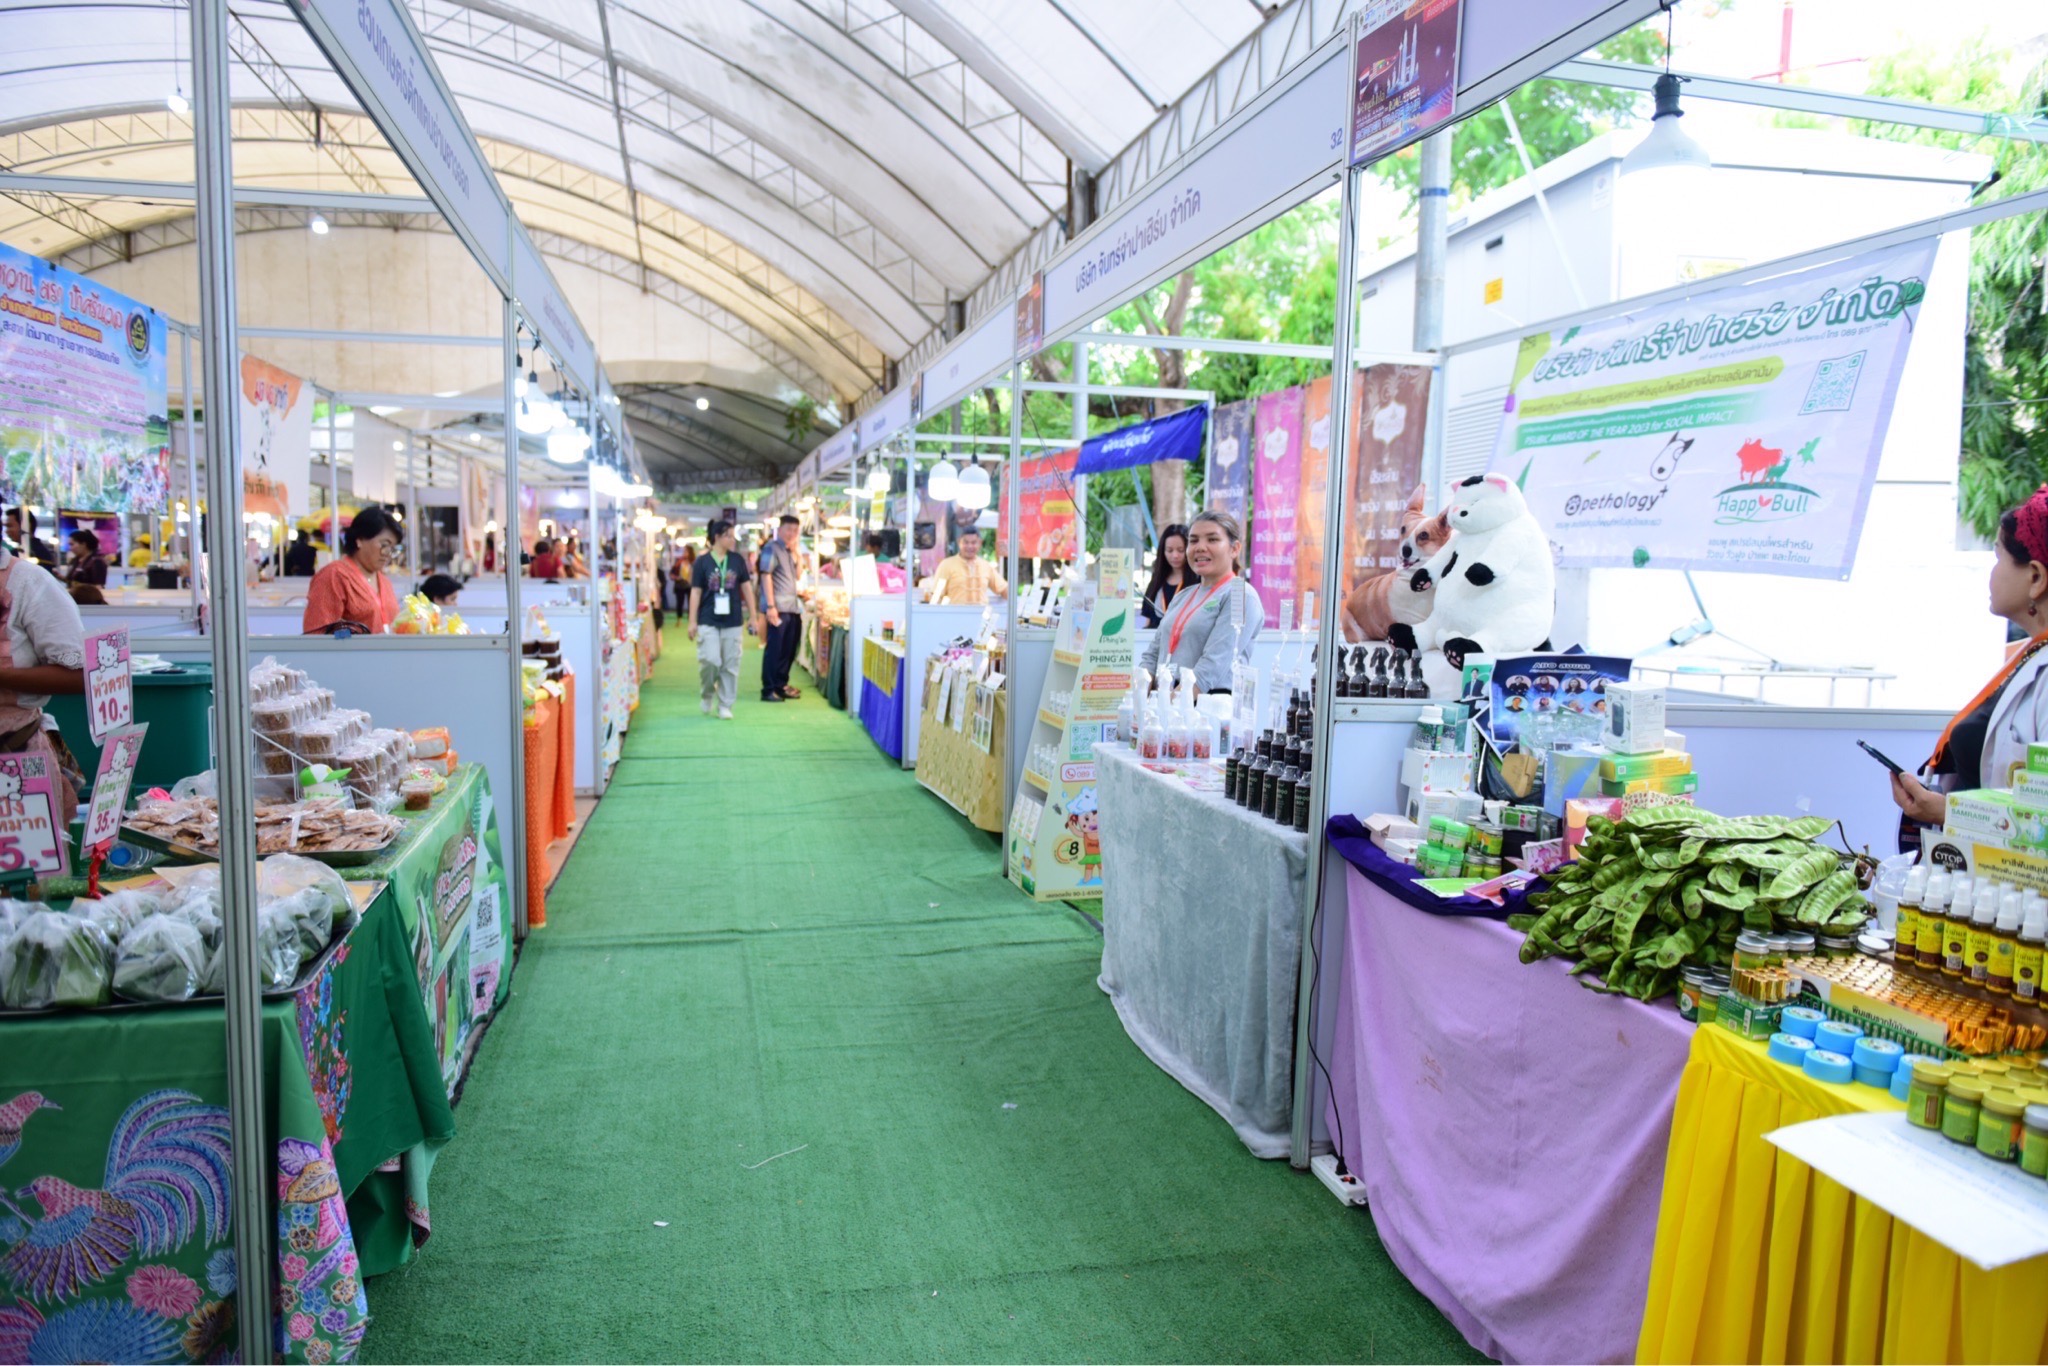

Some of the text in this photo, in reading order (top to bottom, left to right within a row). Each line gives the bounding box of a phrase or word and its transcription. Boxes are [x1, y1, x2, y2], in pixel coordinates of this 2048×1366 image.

[1330, 127, 1343, 151] 32
[1075, 262, 1096, 293] บริษัท
[1170, 188, 1202, 236] จำกัด
[1533, 343, 1597, 382] บริษัท
[1797, 274, 1905, 330] จำกัด
[1605, 425, 1628, 437] YEAR
[1651, 420, 1663, 432] for
[1664, 416, 1695, 431] SOCIAL
[1696, 411, 1736, 425] IMPACT
[1771, 494, 1809, 513] Bull
[1089, 655, 1132, 664] PHING'AN
[99, 697, 128, 726] 10.-
[1951, 807, 1991, 823] SAMRASRI
[1069, 841, 1079, 856] 8
[1934, 851, 1963, 865] OTOP
